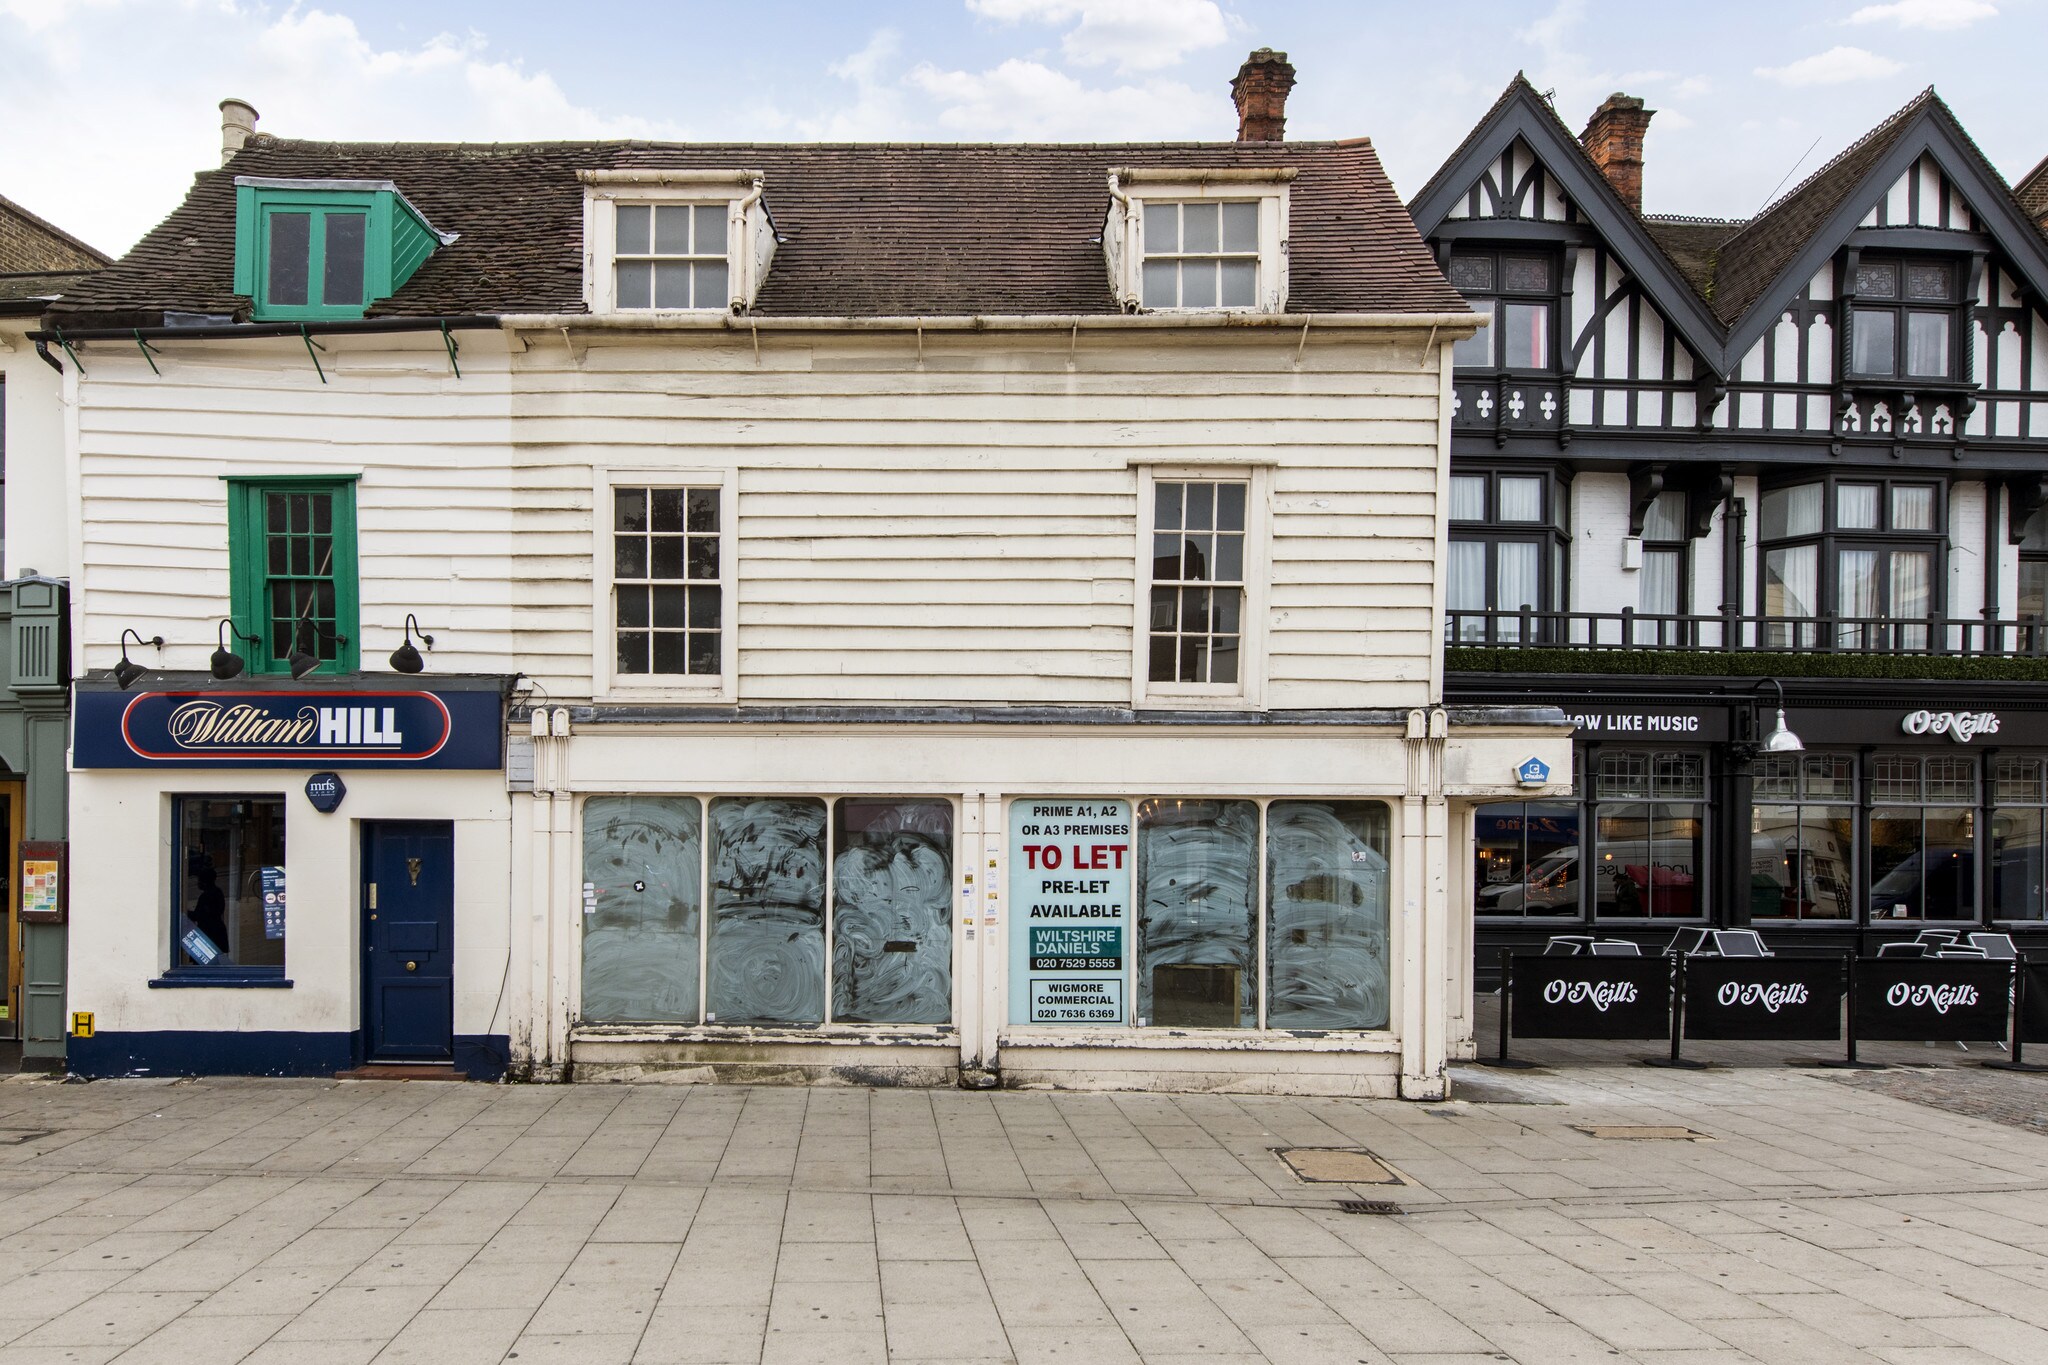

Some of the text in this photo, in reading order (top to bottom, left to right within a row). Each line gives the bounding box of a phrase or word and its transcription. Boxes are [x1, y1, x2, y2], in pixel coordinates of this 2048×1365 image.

[168, 700, 402, 746] William HILL
[1606, 714, 1643, 731] LIKE
[1647, 715, 1699, 732] MUSIC
[1902, 709, 2000, 742] O'Neill's
[1524, 772, 1545, 780] Chubb
[310, 778, 335, 791] mrfs
[1033, 806, 1118, 819] PRIME A1, A2
[1021, 824, 1129, 836] OR A3 PREMISES
[1022, 844, 1128, 870] TO LET
[1041, 880, 1110, 894] PRE-LET
[1029, 904, 1122, 918] AVAILABLE
[1036, 930, 1116, 942] WILTSHIRE
[1036, 943, 1101, 955] DANIELS
[1036, 958, 1116, 968] 020 7529 5555
[1048, 983, 1104, 993] WIGMORE
[1037, 995, 1115, 1005] COMMERCIAL
[1543, 979, 1638, 1012] O'Neill's
[1717, 981, 1809, 1014] O'Neill's
[1886, 982, 1979, 1015] O'Neill's
[1037, 1009, 1115, 1019] 020 7636 6369
